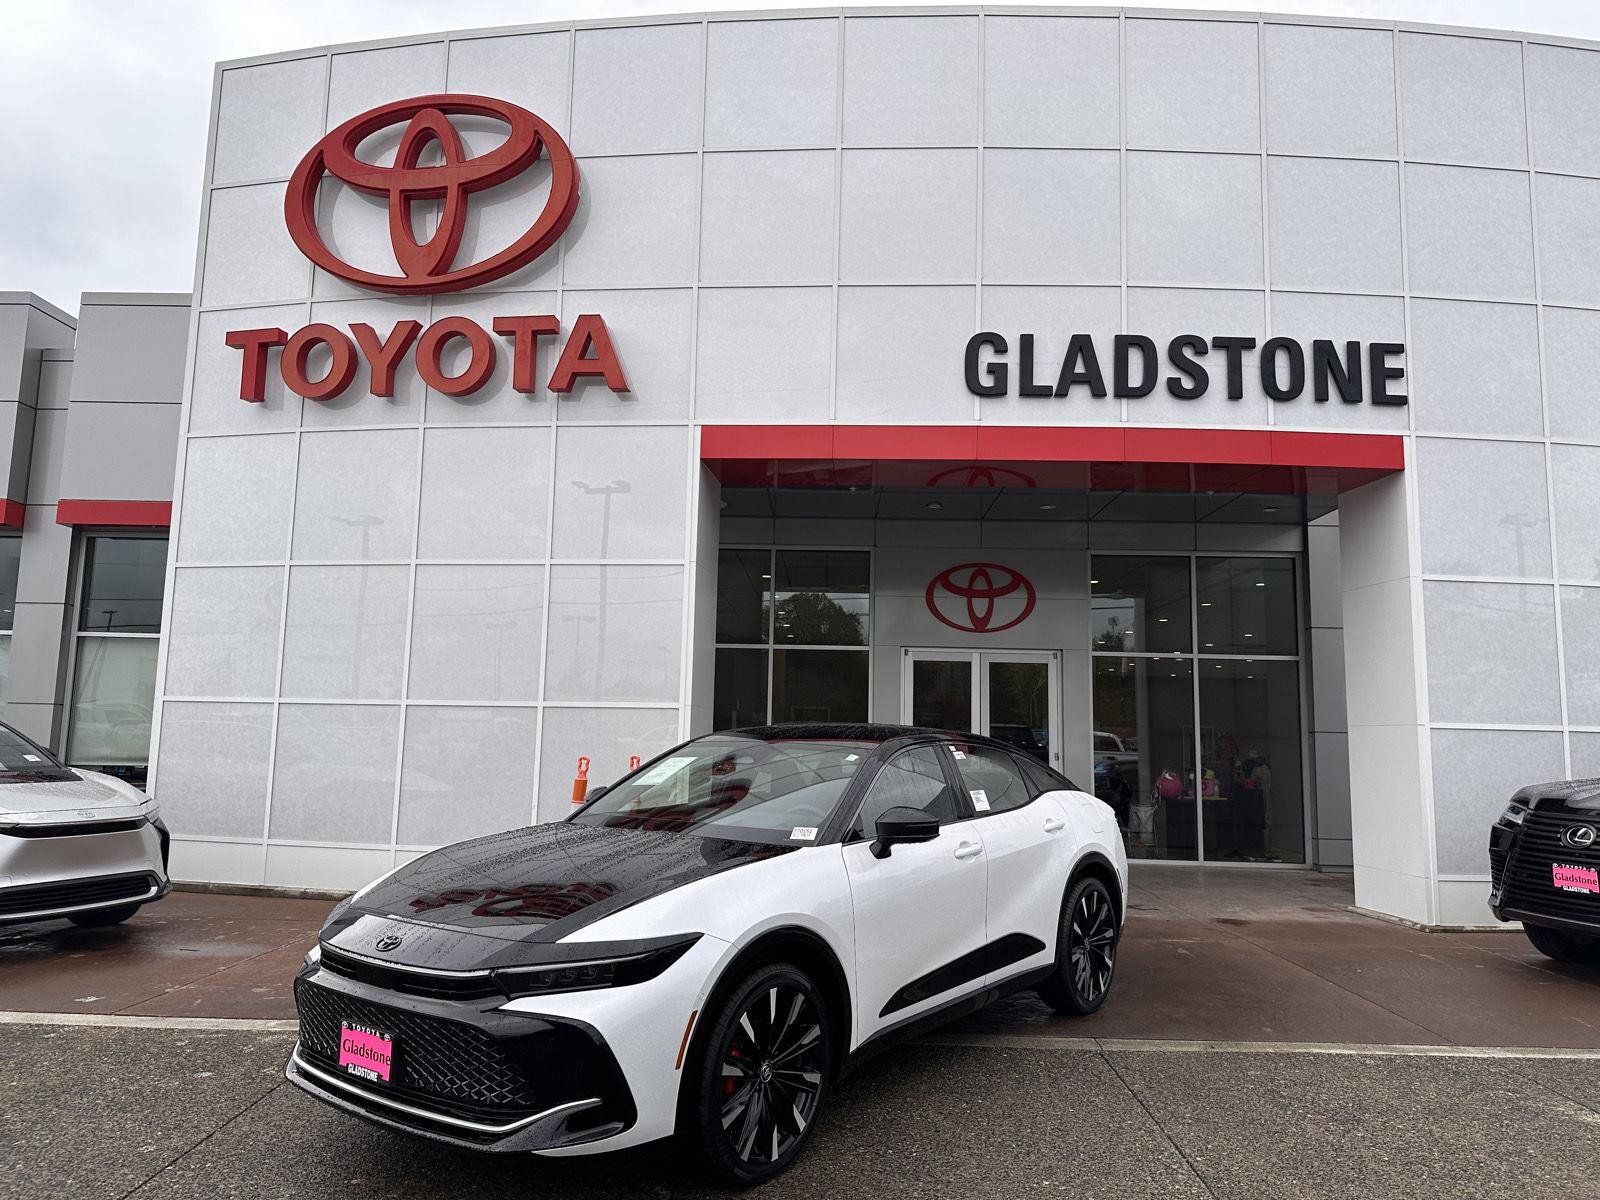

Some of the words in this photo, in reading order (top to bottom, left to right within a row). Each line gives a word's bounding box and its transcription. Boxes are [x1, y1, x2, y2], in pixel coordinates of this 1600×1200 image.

[225, 314, 631, 404] TOYOTA
[964, 331, 1408, 406] GLADSTONE
[1554, 872, 1598, 885] Gladstone
[352, 1023, 380, 1037] TOYOTA
[343, 1038, 391, 1066] Gladstone
[347, 1063, 378, 1082] GLADSTONE
